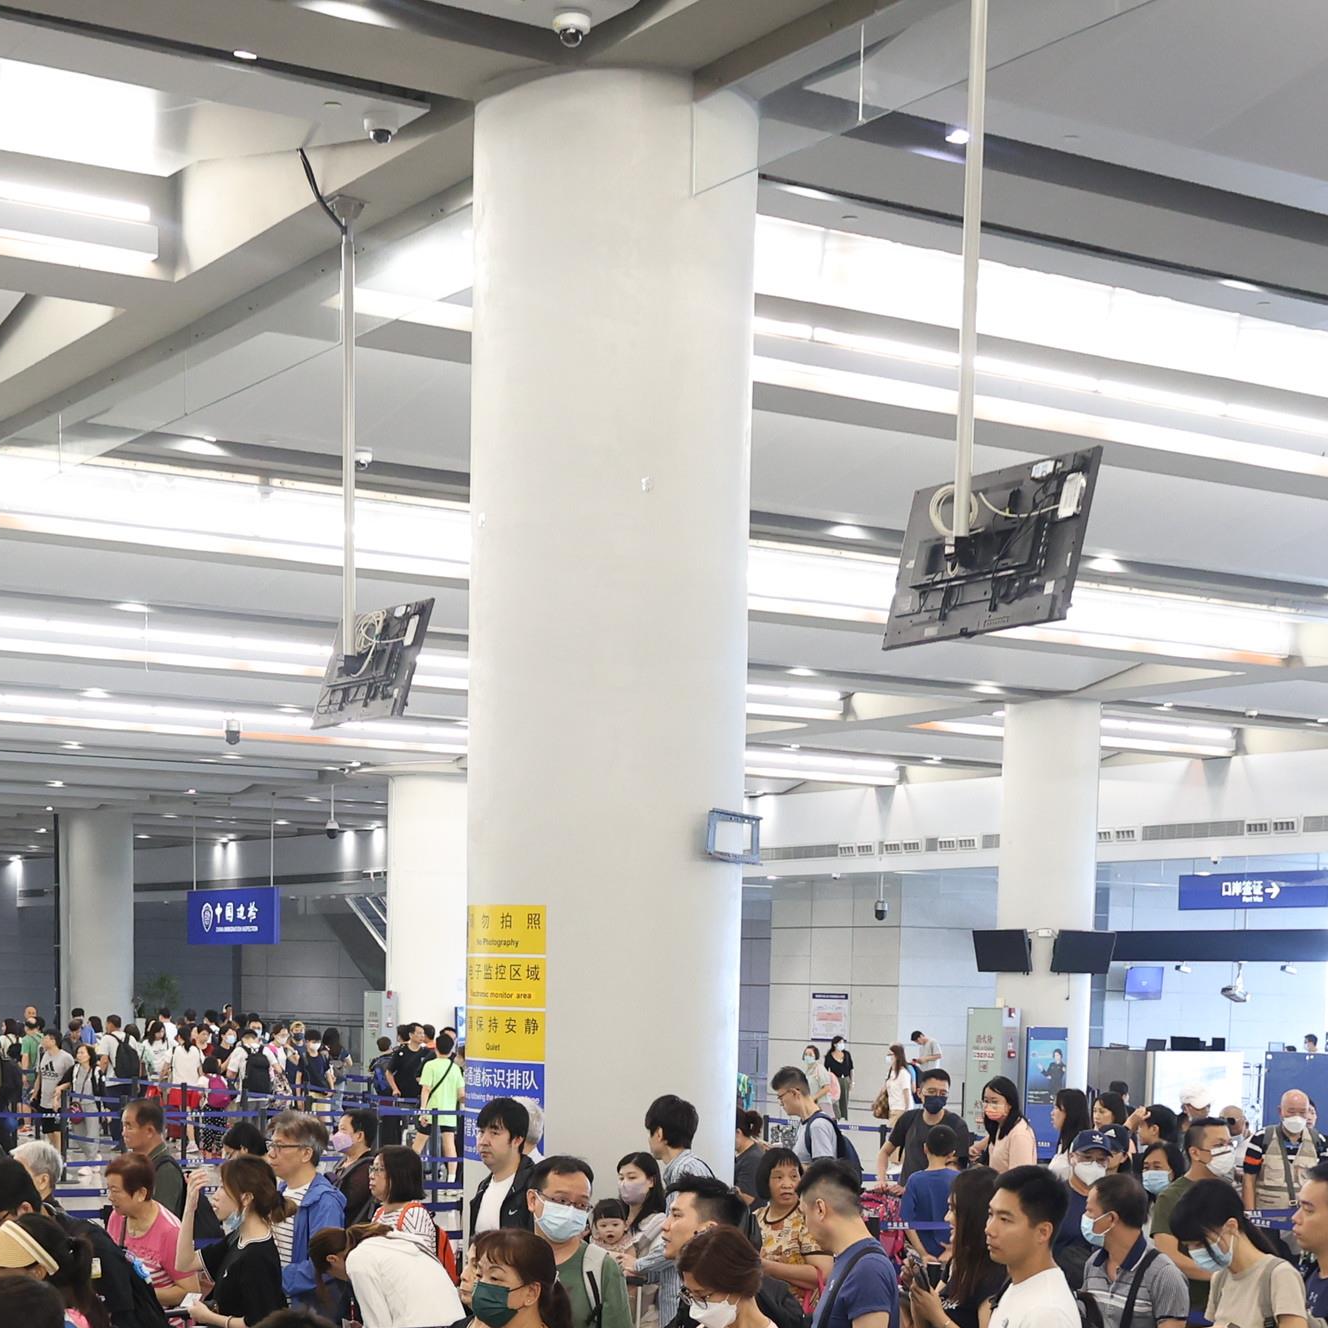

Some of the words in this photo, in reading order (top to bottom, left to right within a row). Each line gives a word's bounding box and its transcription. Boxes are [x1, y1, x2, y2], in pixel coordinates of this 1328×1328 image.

[1221, 880, 1264, 896] 口岸签证
[482, 938, 520, 948] Photography
[489, 991, 514, 999] monitor
[485, 1041, 501, 1052] Quiet
